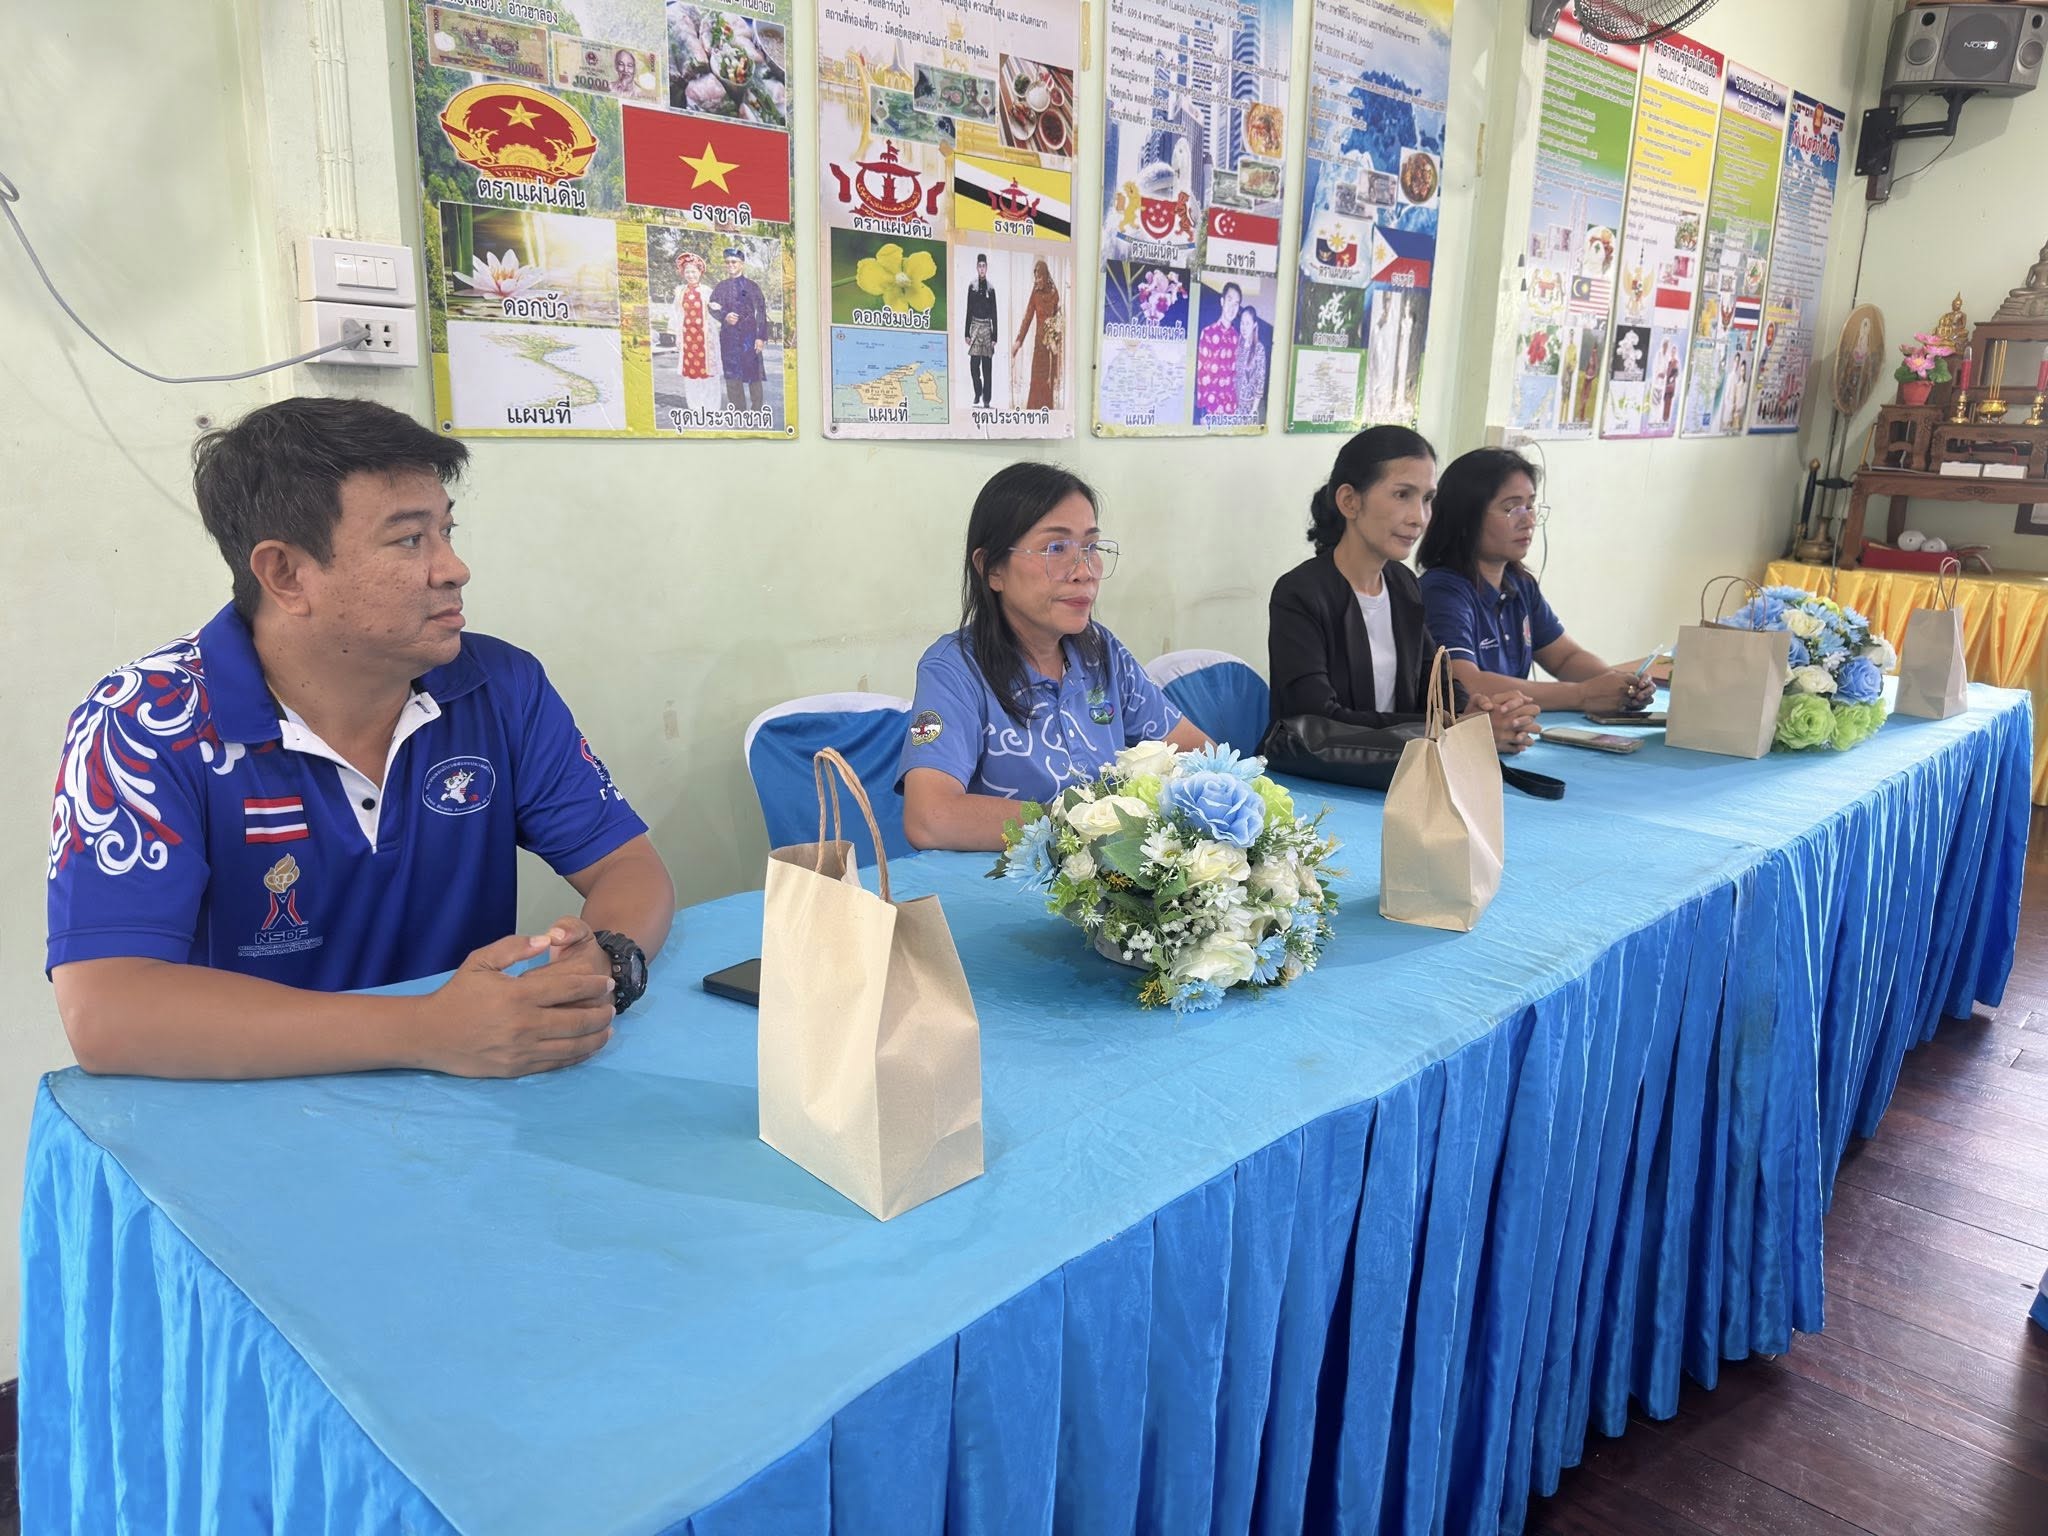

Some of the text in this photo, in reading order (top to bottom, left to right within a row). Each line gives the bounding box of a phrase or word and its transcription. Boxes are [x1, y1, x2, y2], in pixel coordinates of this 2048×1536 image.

[825, 6, 878, 31] สถานที่ท่องเที่ยว
[478, 178, 586, 208] ตราแผ่นดิน
[693, 204, 751, 226] ธงชาติ
[853, 216, 932, 238] ตราแผ่นดิน
[995, 219, 1034, 236] ธงชาติ
[1226, 251, 1256, 268] ธงชาติ
[504, 293, 568, 320] ดอกบัว
[853, 307, 930, 328] ดอกซิมปอร์
[507, 396, 572, 425] แผนที่
[670, 405, 773, 432] ชุดประจำชาติ
[868, 397, 908, 422] แผนที่
[972, 409, 1049, 430] ชุดประจำชาติ
[1125, 409, 1155, 426] แผนที่
[255, 927, 308, 945] NSDF
